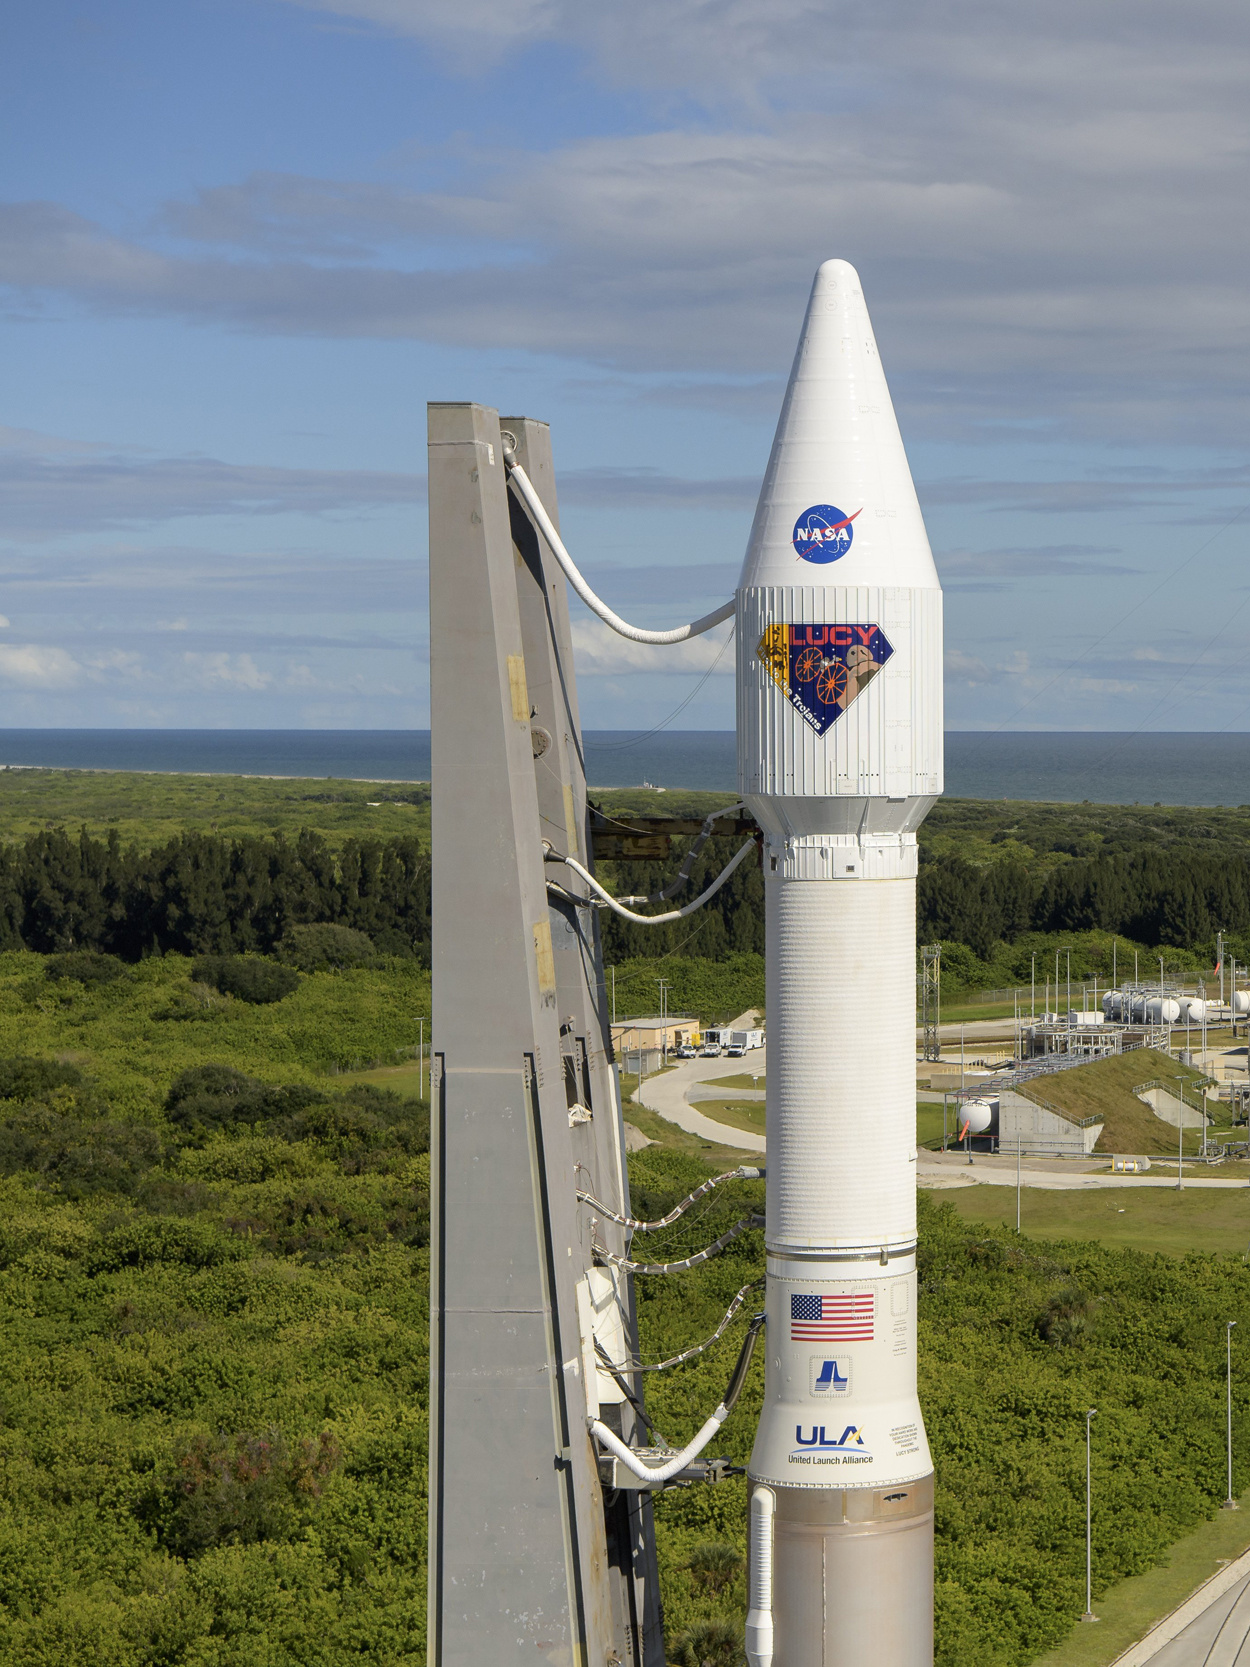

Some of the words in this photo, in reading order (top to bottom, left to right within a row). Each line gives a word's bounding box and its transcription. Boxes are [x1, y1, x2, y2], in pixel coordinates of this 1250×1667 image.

[797, 528, 850, 541] NASA
[790, 626, 877, 645] LUCY
[792, 694, 822, 730] Trojans
[796, 1425, 864, 1445] ULA
[788, 1455, 810, 1464] United
[813, 1456, 840, 1464] Launch
[842, 1456, 873, 1464] Alliance
